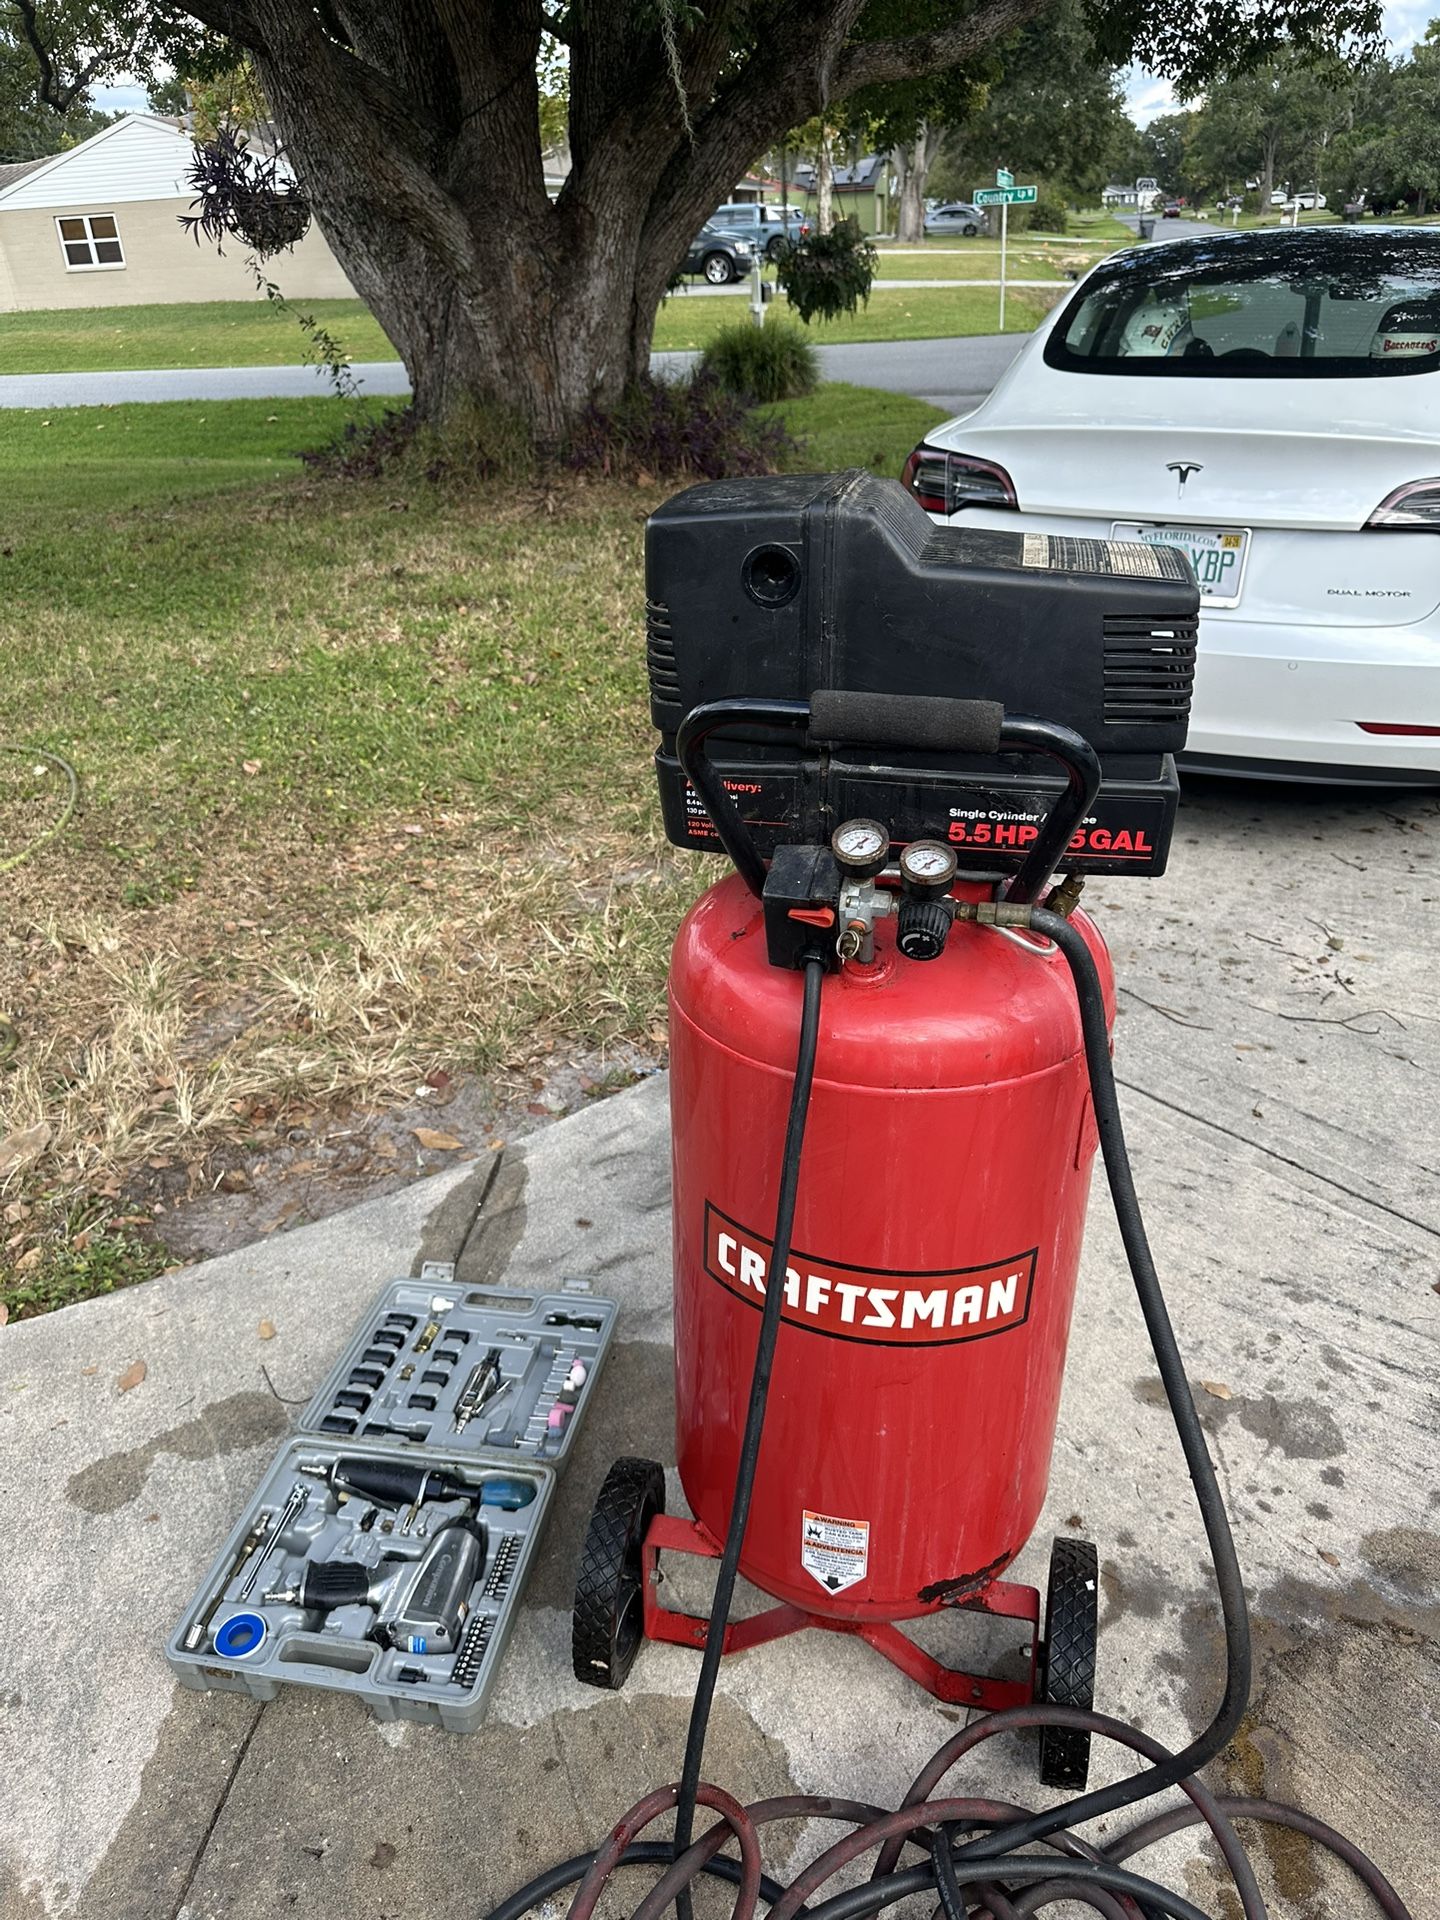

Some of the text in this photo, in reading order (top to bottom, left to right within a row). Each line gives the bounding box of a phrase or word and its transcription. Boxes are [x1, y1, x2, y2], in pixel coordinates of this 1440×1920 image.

[976, 191, 1014, 204] Country
[1384, 339, 1437, 352] BUCCANEERS
[1327, 589, 1412, 598] DUAL MOTOR
[723, 780, 762, 794] livery:
[949, 808, 987, 820] Single
[988, 810, 1040, 822] Cylinder
[688, 829, 709, 837] ASME
[948, 821, 992, 844] 5.5
[994, 823, 1040, 846] HP
[1089, 830, 1152, 851] GAL
[718, 1232, 1020, 1329] CRAFTSMAN
[820, 1517, 856, 1528] WARNING
[811, 1543, 864, 1555] ADVERTENCIA
